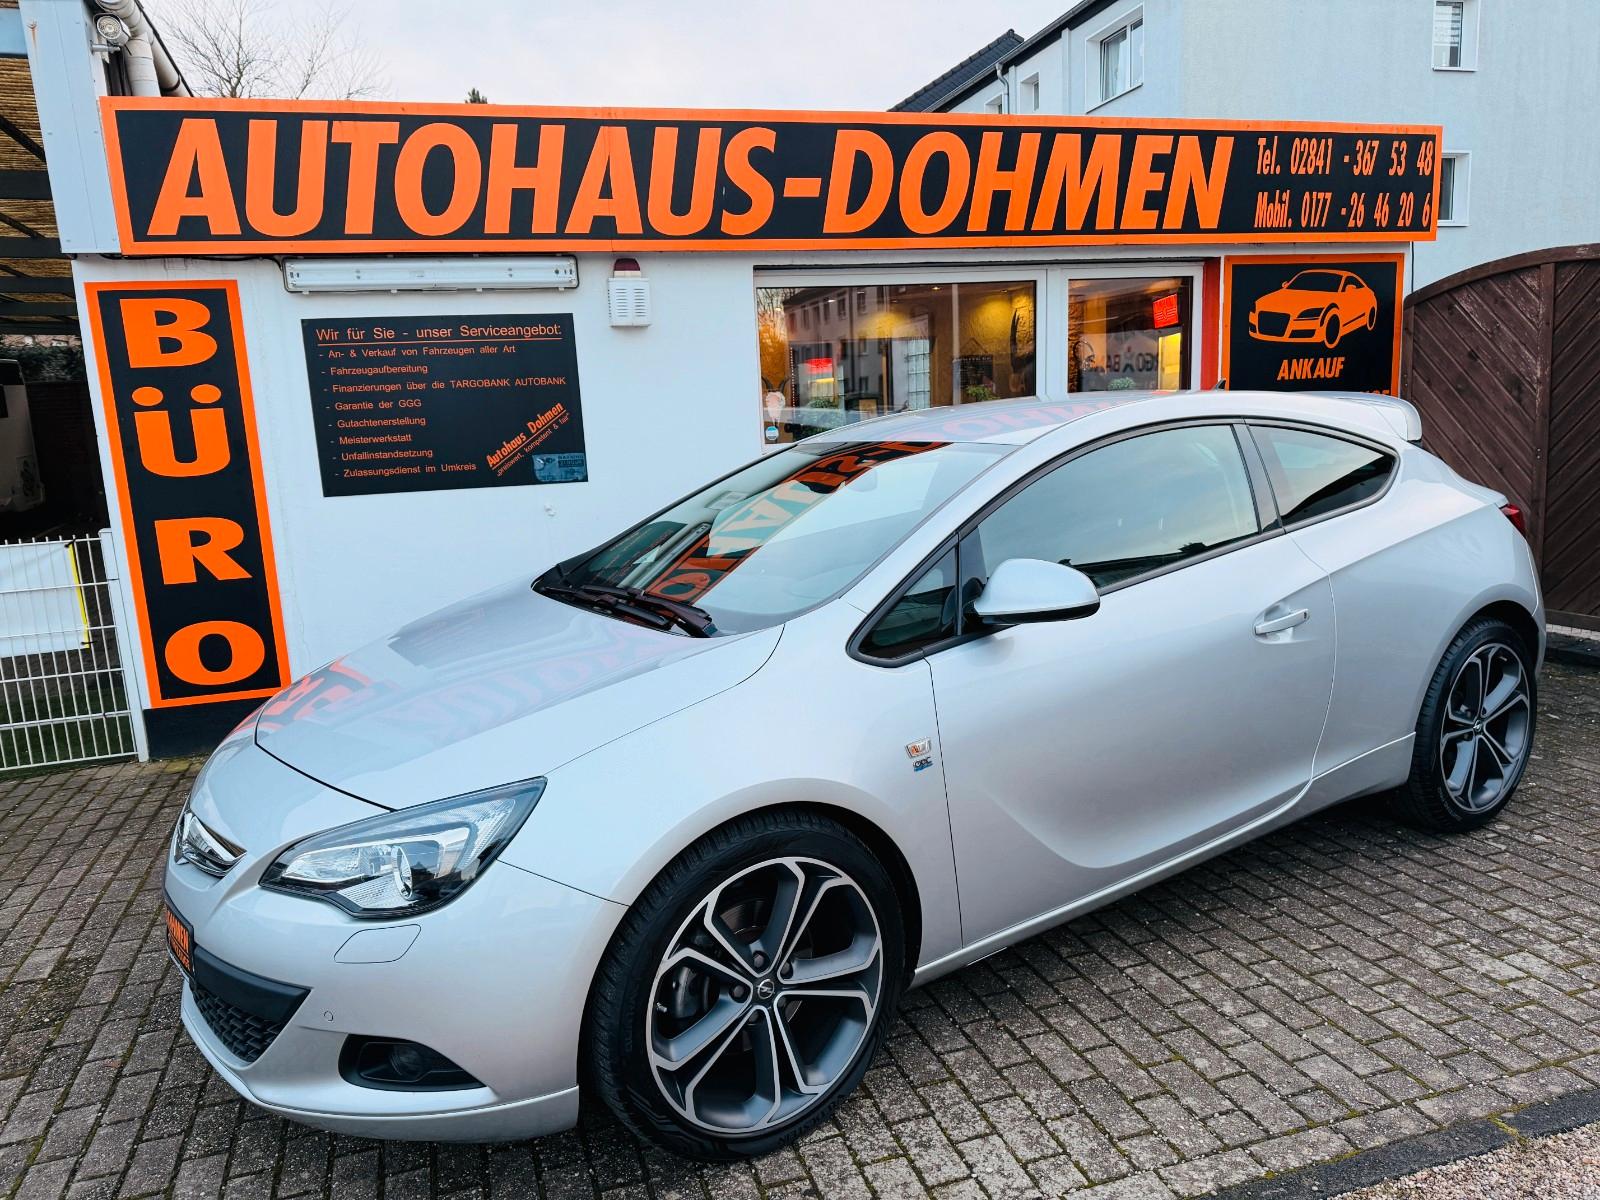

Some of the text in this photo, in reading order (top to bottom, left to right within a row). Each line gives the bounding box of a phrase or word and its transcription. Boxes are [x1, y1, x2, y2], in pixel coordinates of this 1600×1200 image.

[1256, 136, 1280, 174] Tel.
[1290, 137, 1333, 175] 02841
[1388, 140, 1407, 176] 53
[1417, 140, 1433, 176] 48
[146, 118, 1232, 236] AUTOHAUS-DOHMEN
[1254, 190, 1292, 228] Mobil.
[1300, 191, 1333, 228] 0177
[1373, 192, 1390, 228] 46
[1397, 191, 1414, 227] 20
[1422, 192, 1431, 227] 6
[316, 328, 339, 340] Wir
[347, 327, 365, 340] für
[373, 327, 395, 339] Sie
[416, 327, 452, 338] unser
[460, 324, 562, 338] Serviceangebot:
[328, 349, 345, 358] An-
[349, 349, 357, 358] &
[362, 348, 397, 357] Verkauf
[423, 346, 475, 356] Fahrzeugen
[480, 345, 499, 354] aller
[503, 345, 516, 353] Art
[330, 364, 428, 376] Fahrzeugaufbereitung
[1276, 356, 1346, 381] ANKAUF
[332, 382, 402, 393] Finanzierungen
[407, 381, 427, 390] über
[432, 381, 445, 389] die
[450, 378, 511, 389] TARGOBANK
[515, 377, 566, 386] AUTOBANK
[335, 401, 374, 411] Garantie
[378, 400, 393, 409] der
[398, 399, 422, 408] GGG
[337, 417, 426, 428] Gutachtenerstellung
[339, 434, 412, 445] Meisterwerkstatt
[486, 402, 564, 467] Autohaus Dohmen
[523, 428, 552, 453] kompetent
[342, 449, 433, 461] Unfallinstandsetzung
[344, 465, 421, 478] Zulassungsdienst
[441, 463, 477, 472] Umkreis
